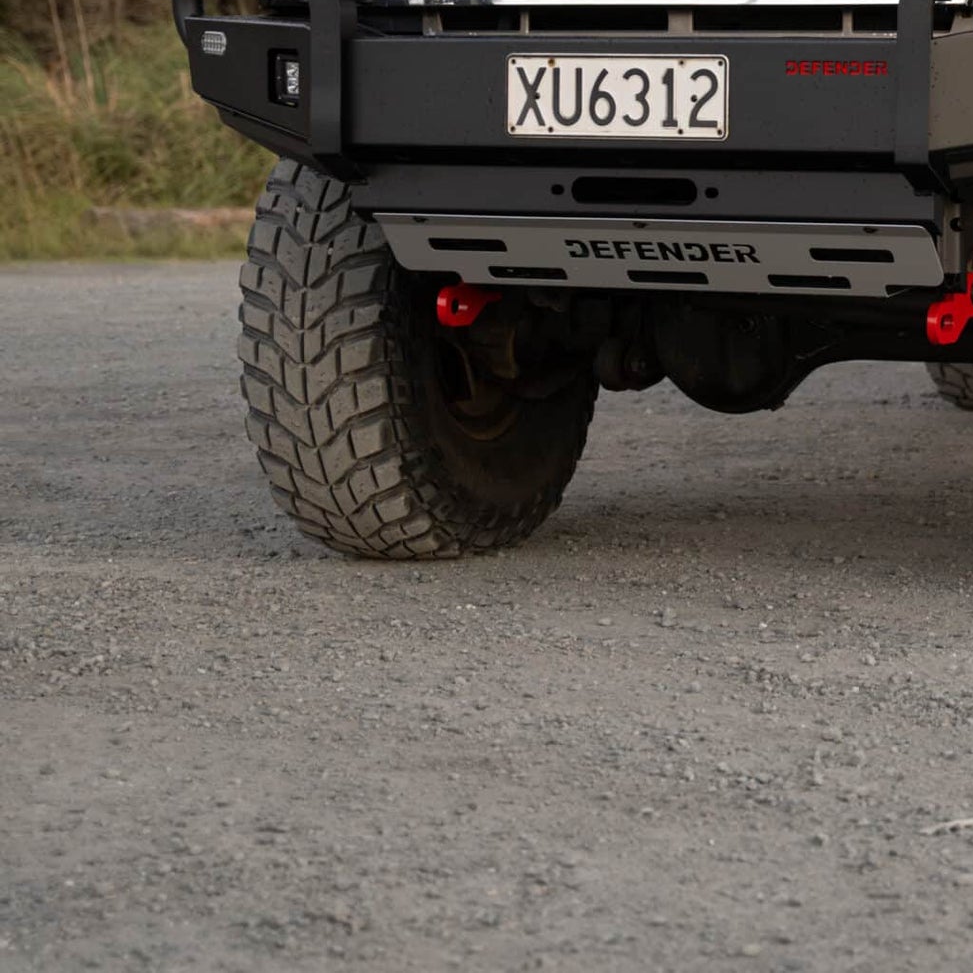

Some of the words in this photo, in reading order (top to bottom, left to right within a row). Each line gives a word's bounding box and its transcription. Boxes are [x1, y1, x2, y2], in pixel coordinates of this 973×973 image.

[785, 60, 888, 76] DEFENDER
[515, 67, 719, 128] XU6312
[564, 239, 761, 264] DEFENDER
